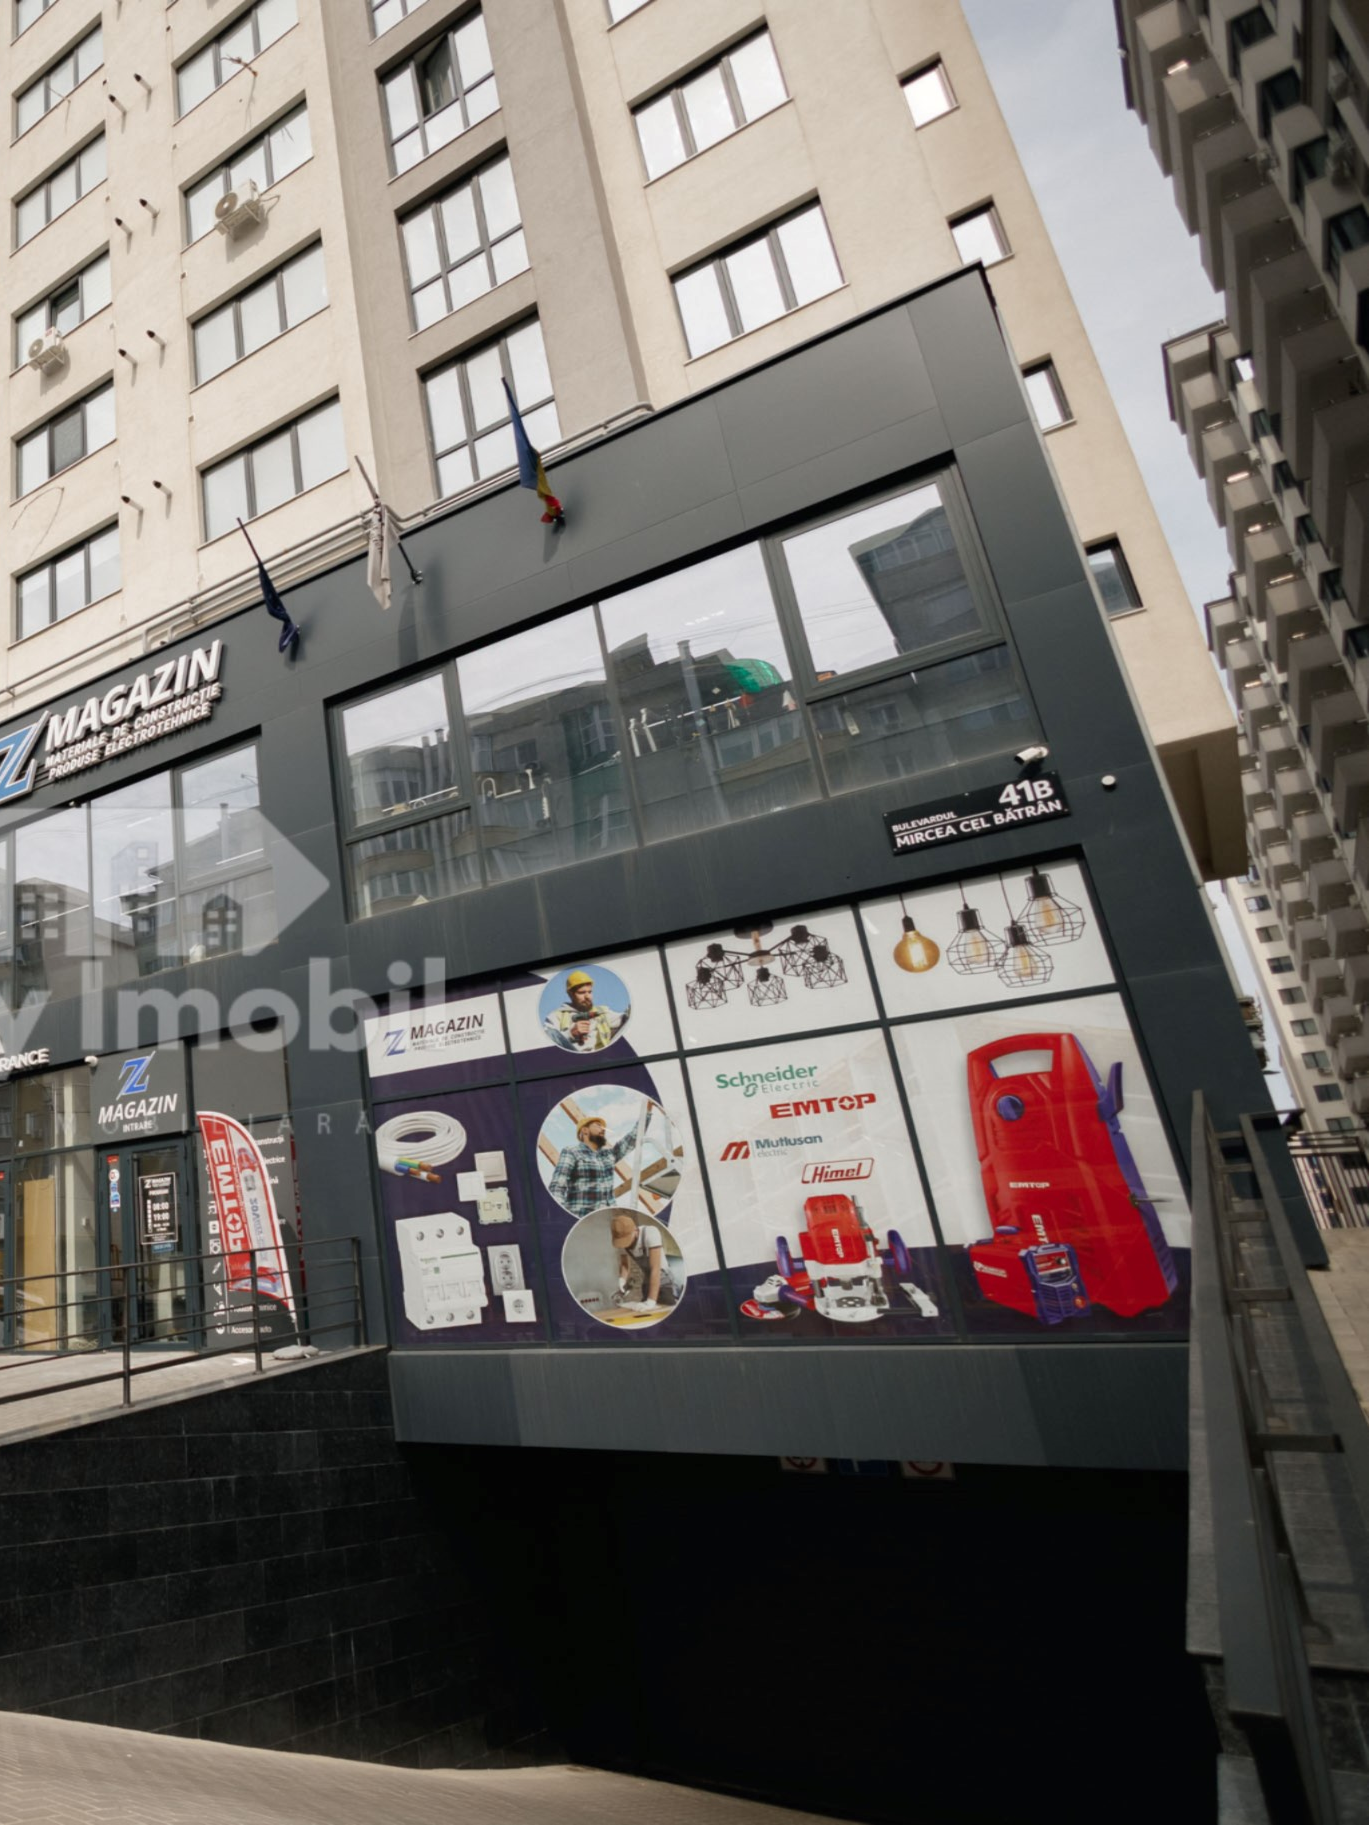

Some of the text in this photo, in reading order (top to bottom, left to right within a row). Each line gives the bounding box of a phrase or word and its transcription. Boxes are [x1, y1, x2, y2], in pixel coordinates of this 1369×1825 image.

[44, 638, 223, 752] MAGAZIN
[44, 681, 223, 769] MATERIALE DE CONSTRUCTIE
[48, 702, 213, 781] PRODUSE ELECTROTEHNICE
[998, 779, 1054, 806] 41B
[892, 811, 958, 833] BULEVARDUL
[895, 799, 1062, 848] MIRCEA CEL BĂTRÂN
[410, 1013, 484, 1041] MAGAZIN
[715, 1064, 818, 1090] Schneider
[761, 1079, 821, 1094] Electric
[98, 1093, 178, 1125] MAGAZIN
[769, 1093, 877, 1120] EMTOP
[122, 1119, 153, 1134] INTRARE
[755, 1134, 823, 1150] Mutlusan
[812, 1162, 863, 1184] Himel
[1008, 1181, 1051, 1189] EMTOP
[1031, 1214, 1050, 1244] EMT
